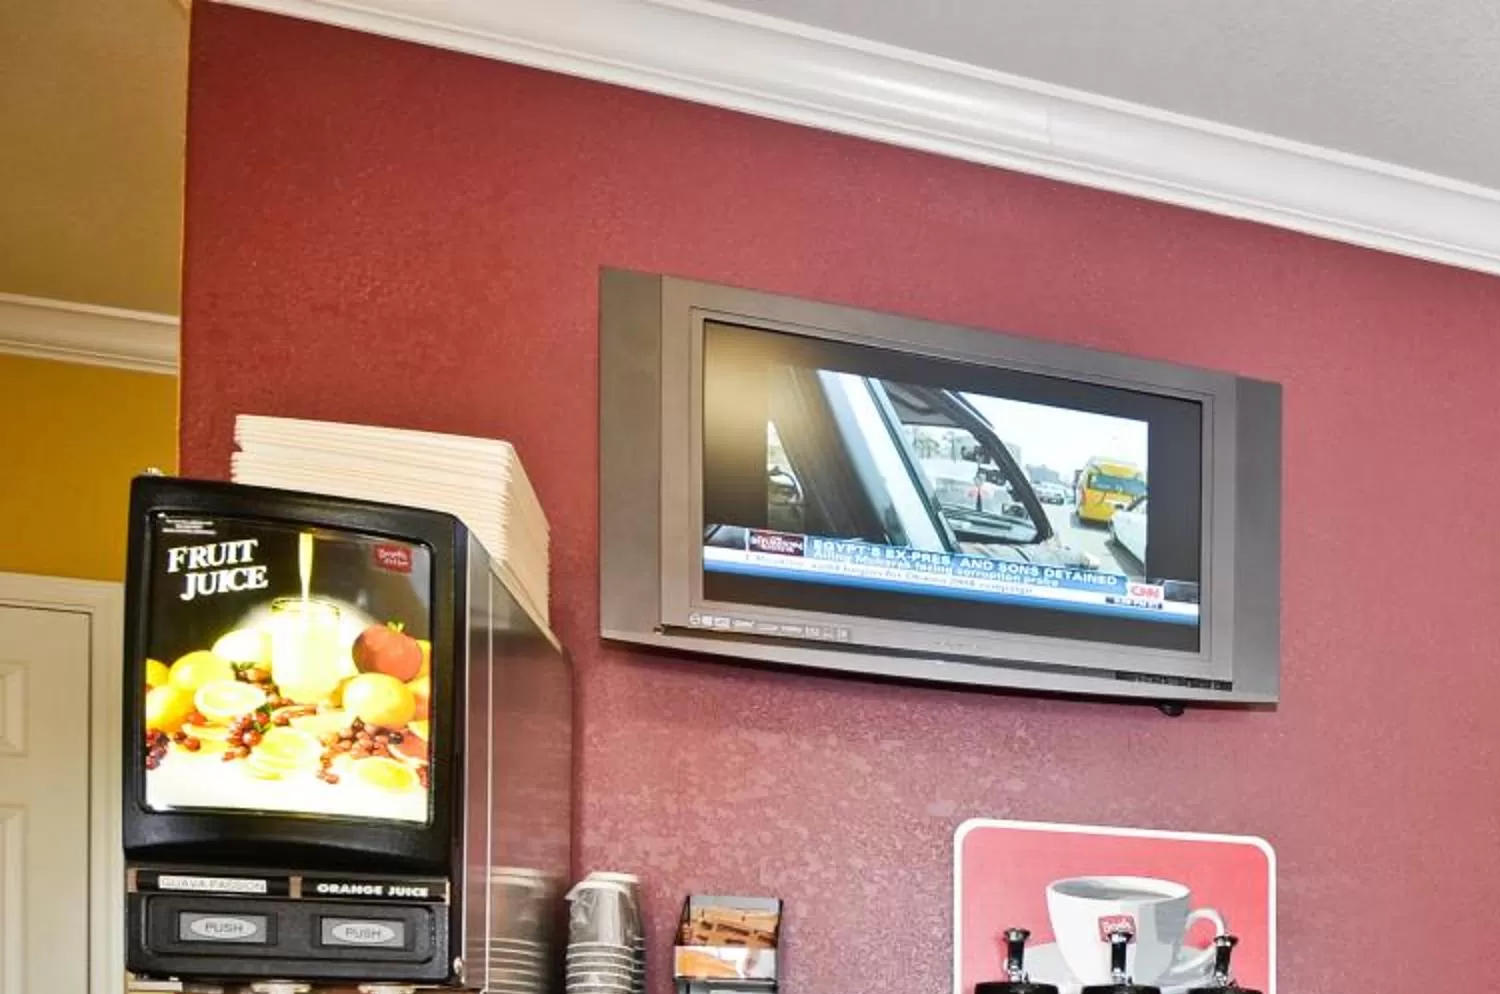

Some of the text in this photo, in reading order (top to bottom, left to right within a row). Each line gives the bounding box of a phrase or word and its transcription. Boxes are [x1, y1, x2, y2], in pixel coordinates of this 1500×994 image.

[167, 539, 259, 573] FRUIT
[960, 557, 994, 571] AND
[999, 561, 1039, 577] SONS
[1043, 567, 1117, 586] DETAINED
[180, 565, 269, 601] JUICE
[1131, 585, 1160, 598] CNN
[316, 883, 429, 898] ORANGE JUICE
[205, 920, 244, 934] PUSH
[345, 926, 381, 939] PUSH
